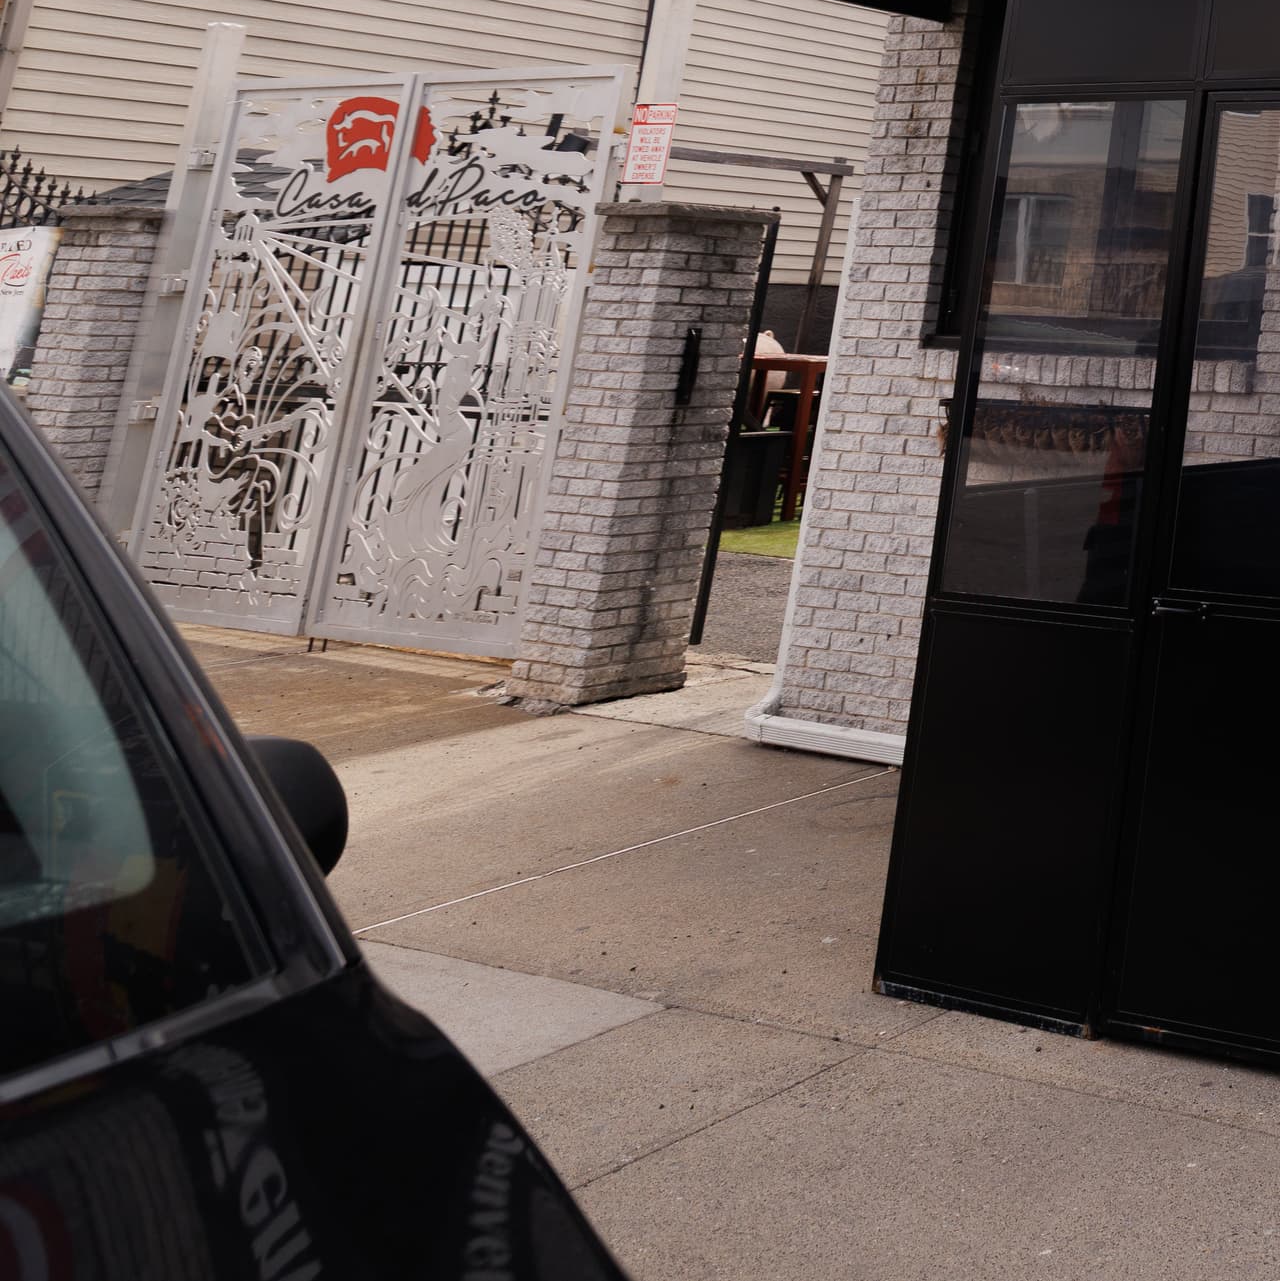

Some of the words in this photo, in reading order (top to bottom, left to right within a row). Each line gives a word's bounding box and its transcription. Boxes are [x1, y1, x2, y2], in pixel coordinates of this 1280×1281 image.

[633, 108, 649, 123] NO
[649, 110, 676, 120] PARKING
[638, 127, 666, 135] VIOLATORS
[640, 136, 651, 144] WILL
[640, 154, 662, 162] VEHICLE
[275, 168, 374, 218] Casa
